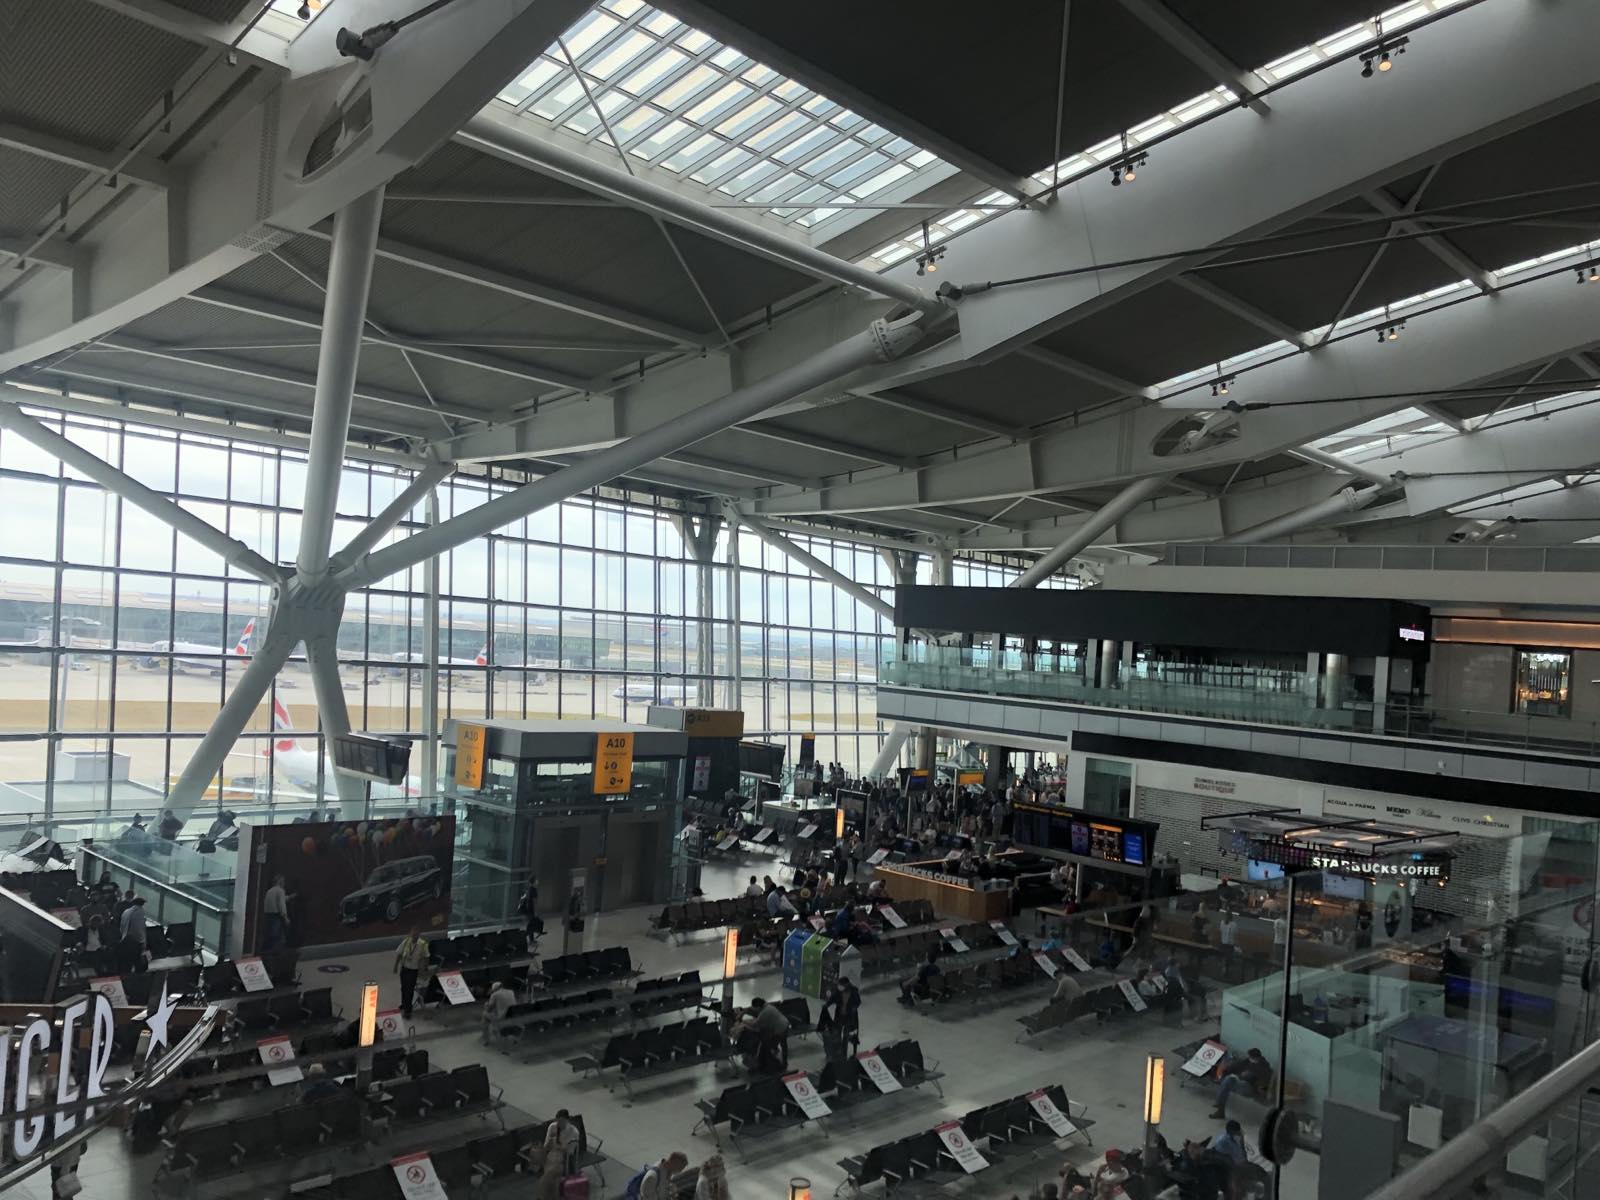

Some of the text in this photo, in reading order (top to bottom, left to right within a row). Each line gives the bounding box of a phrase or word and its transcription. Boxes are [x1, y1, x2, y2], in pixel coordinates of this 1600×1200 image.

[464, 730, 479, 741] A10
[606, 738, 626, 748] A10
[1193, 782, 1235, 794] BOUTIQUE
[1386, 805, 1411, 815] MEMO
[1312, 857, 1440, 876] STARBUCKS COFFEE
[934, 872, 969, 887] COFFEE
[0, 994, 115, 1157] GER
